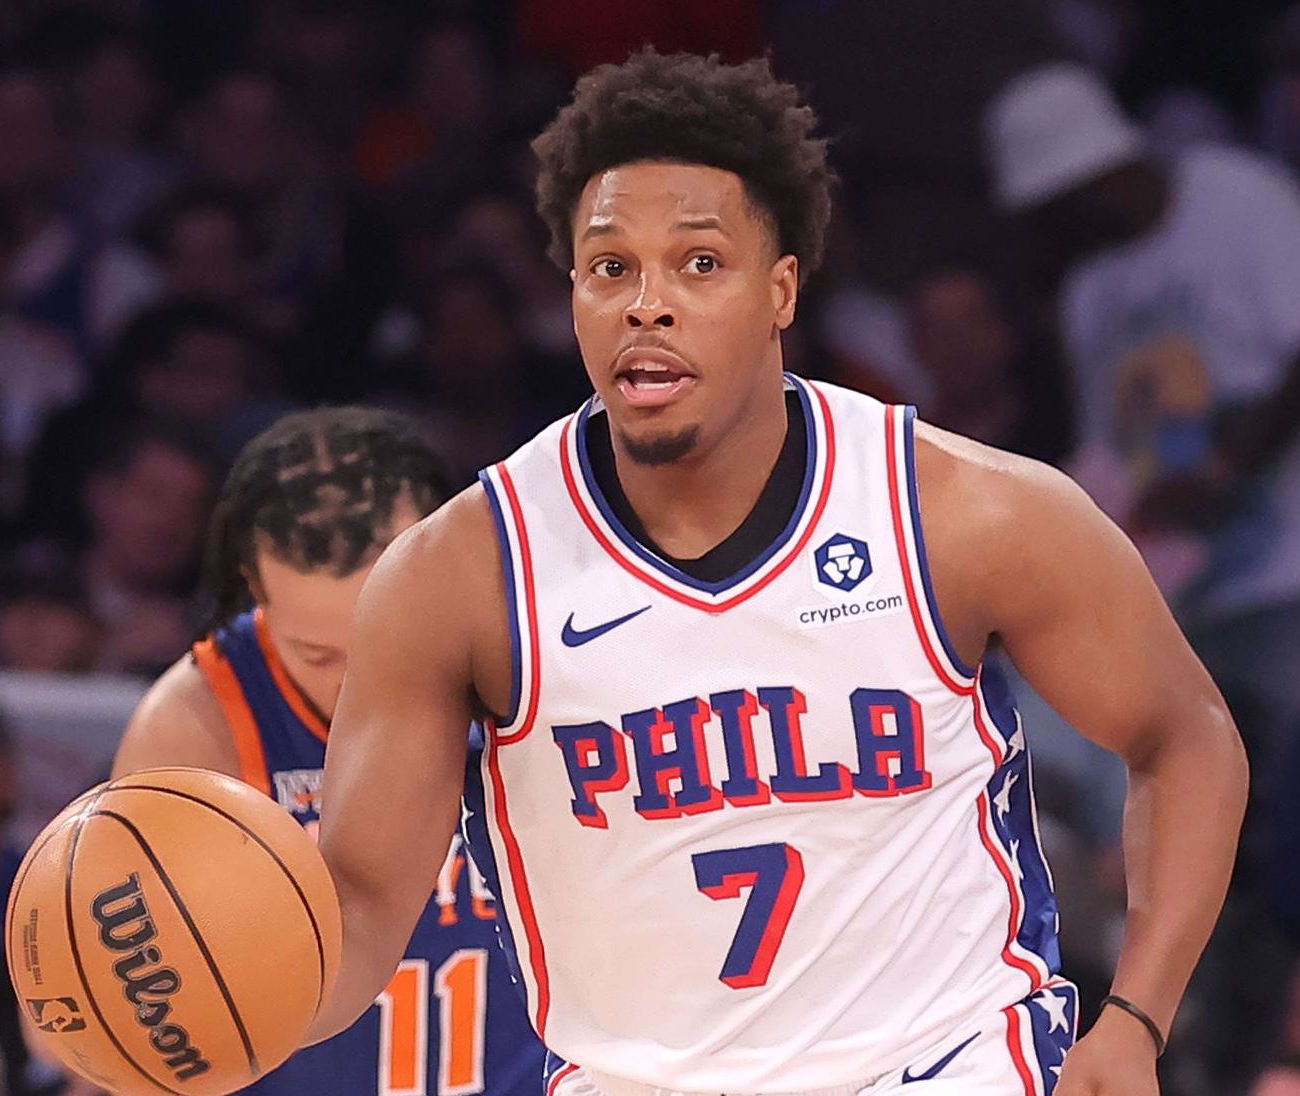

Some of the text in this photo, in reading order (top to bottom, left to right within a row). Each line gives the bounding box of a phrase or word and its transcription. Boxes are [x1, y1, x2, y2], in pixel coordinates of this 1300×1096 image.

[799, 595, 903, 624] crypto.com
[551, 686, 933, 830] PHILA
[89, 872, 212, 1083] Wilson
[691, 842, 805, 990] 7
